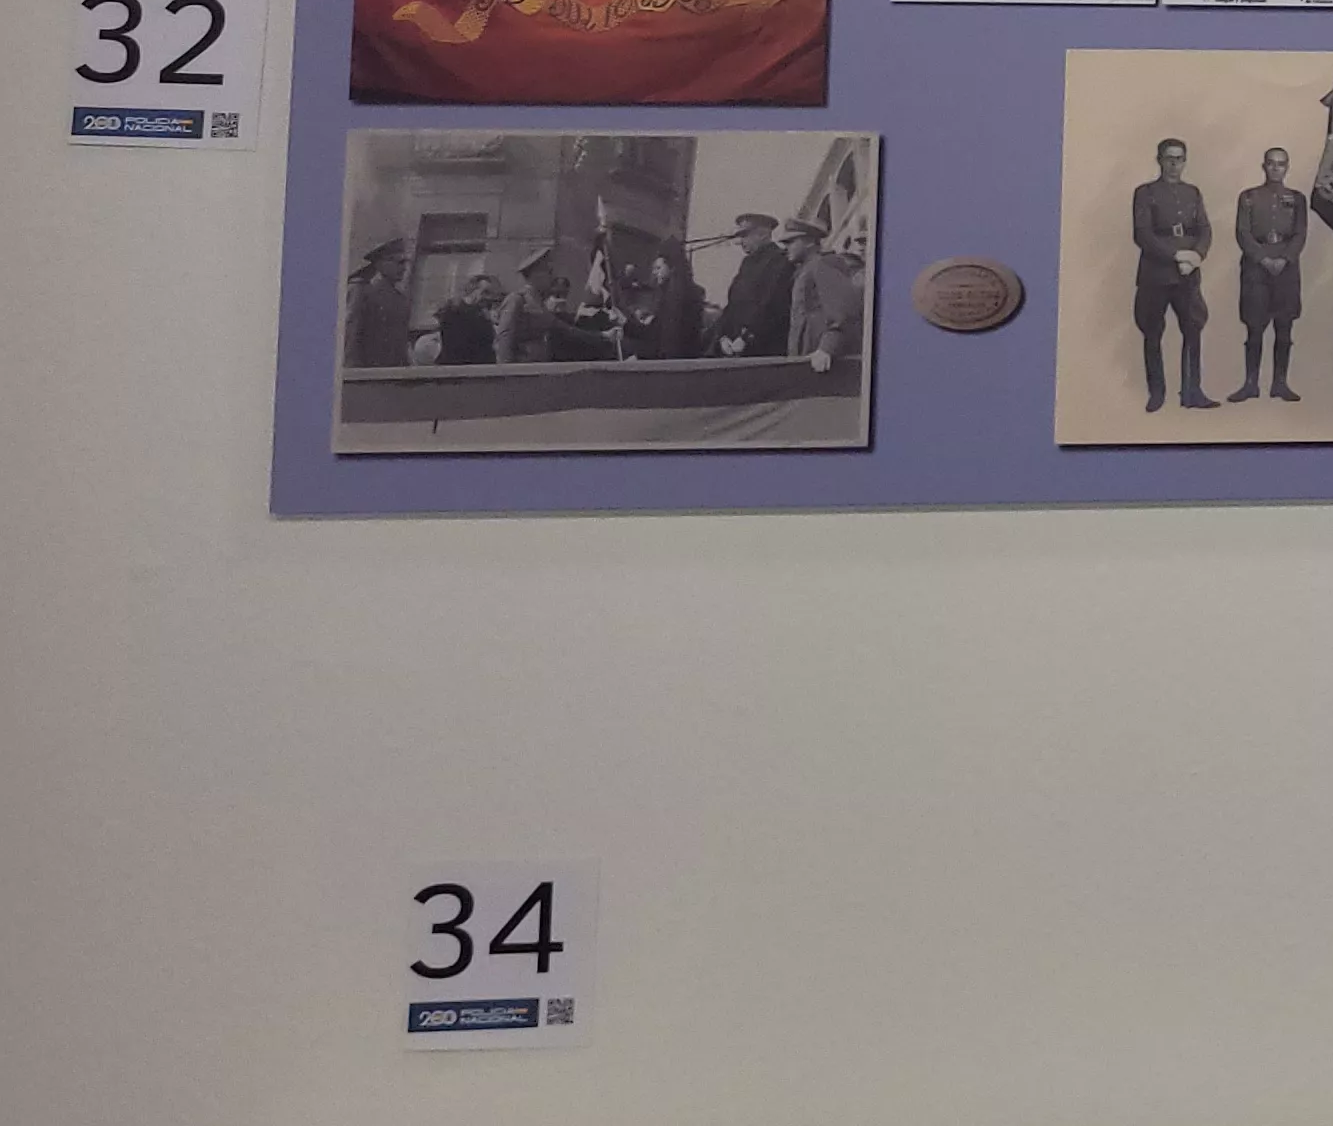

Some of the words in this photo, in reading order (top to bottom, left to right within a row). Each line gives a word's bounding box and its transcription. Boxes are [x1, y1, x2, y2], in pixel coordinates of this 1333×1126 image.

[83, 115, 121, 131] 200
[124, 124, 193, 133] NACIONAL
[410, 881, 564, 979] 34
[419, 1010, 458, 1026] 200
